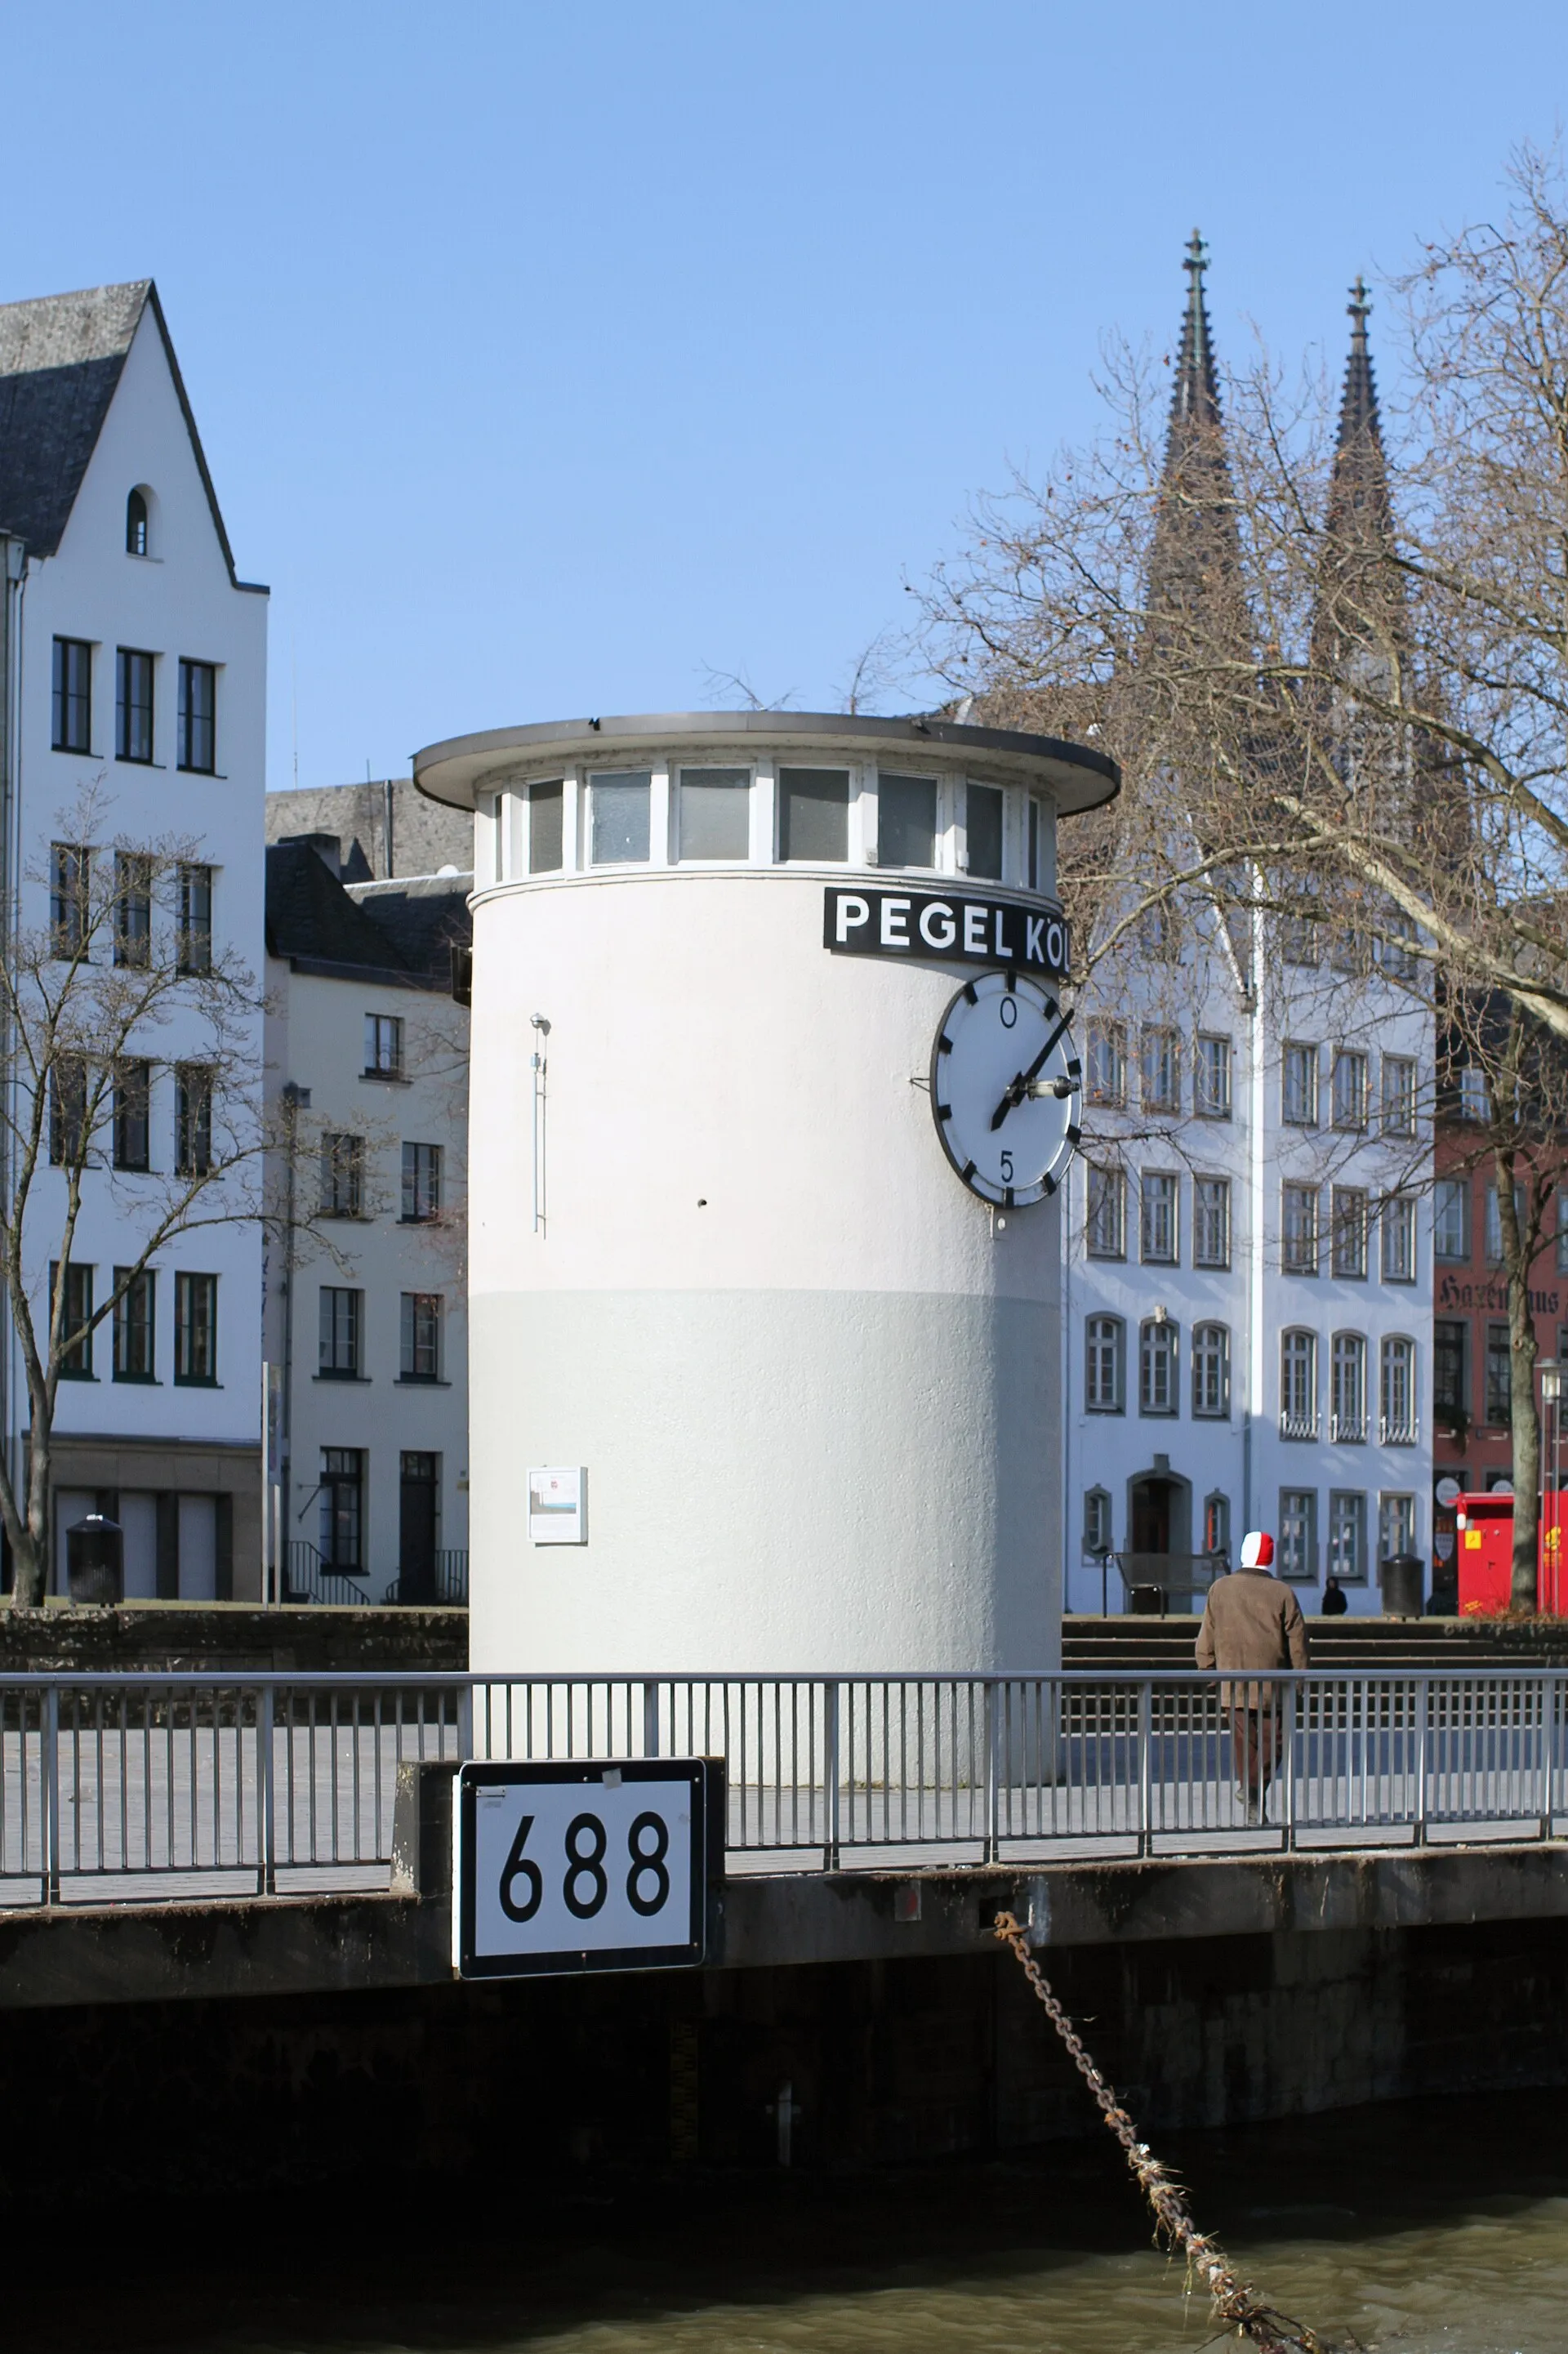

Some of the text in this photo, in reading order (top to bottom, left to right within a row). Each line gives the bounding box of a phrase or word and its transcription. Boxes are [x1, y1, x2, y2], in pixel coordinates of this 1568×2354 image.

[835, 895, 1013, 957] PEGEL
[1000, 996, 1017, 1028] 0
[1000, 1150, 1013, 1183] 5
[1440, 1275, 1558, 1313] Haxenaus
[499, 1811, 670, 1924] 688
